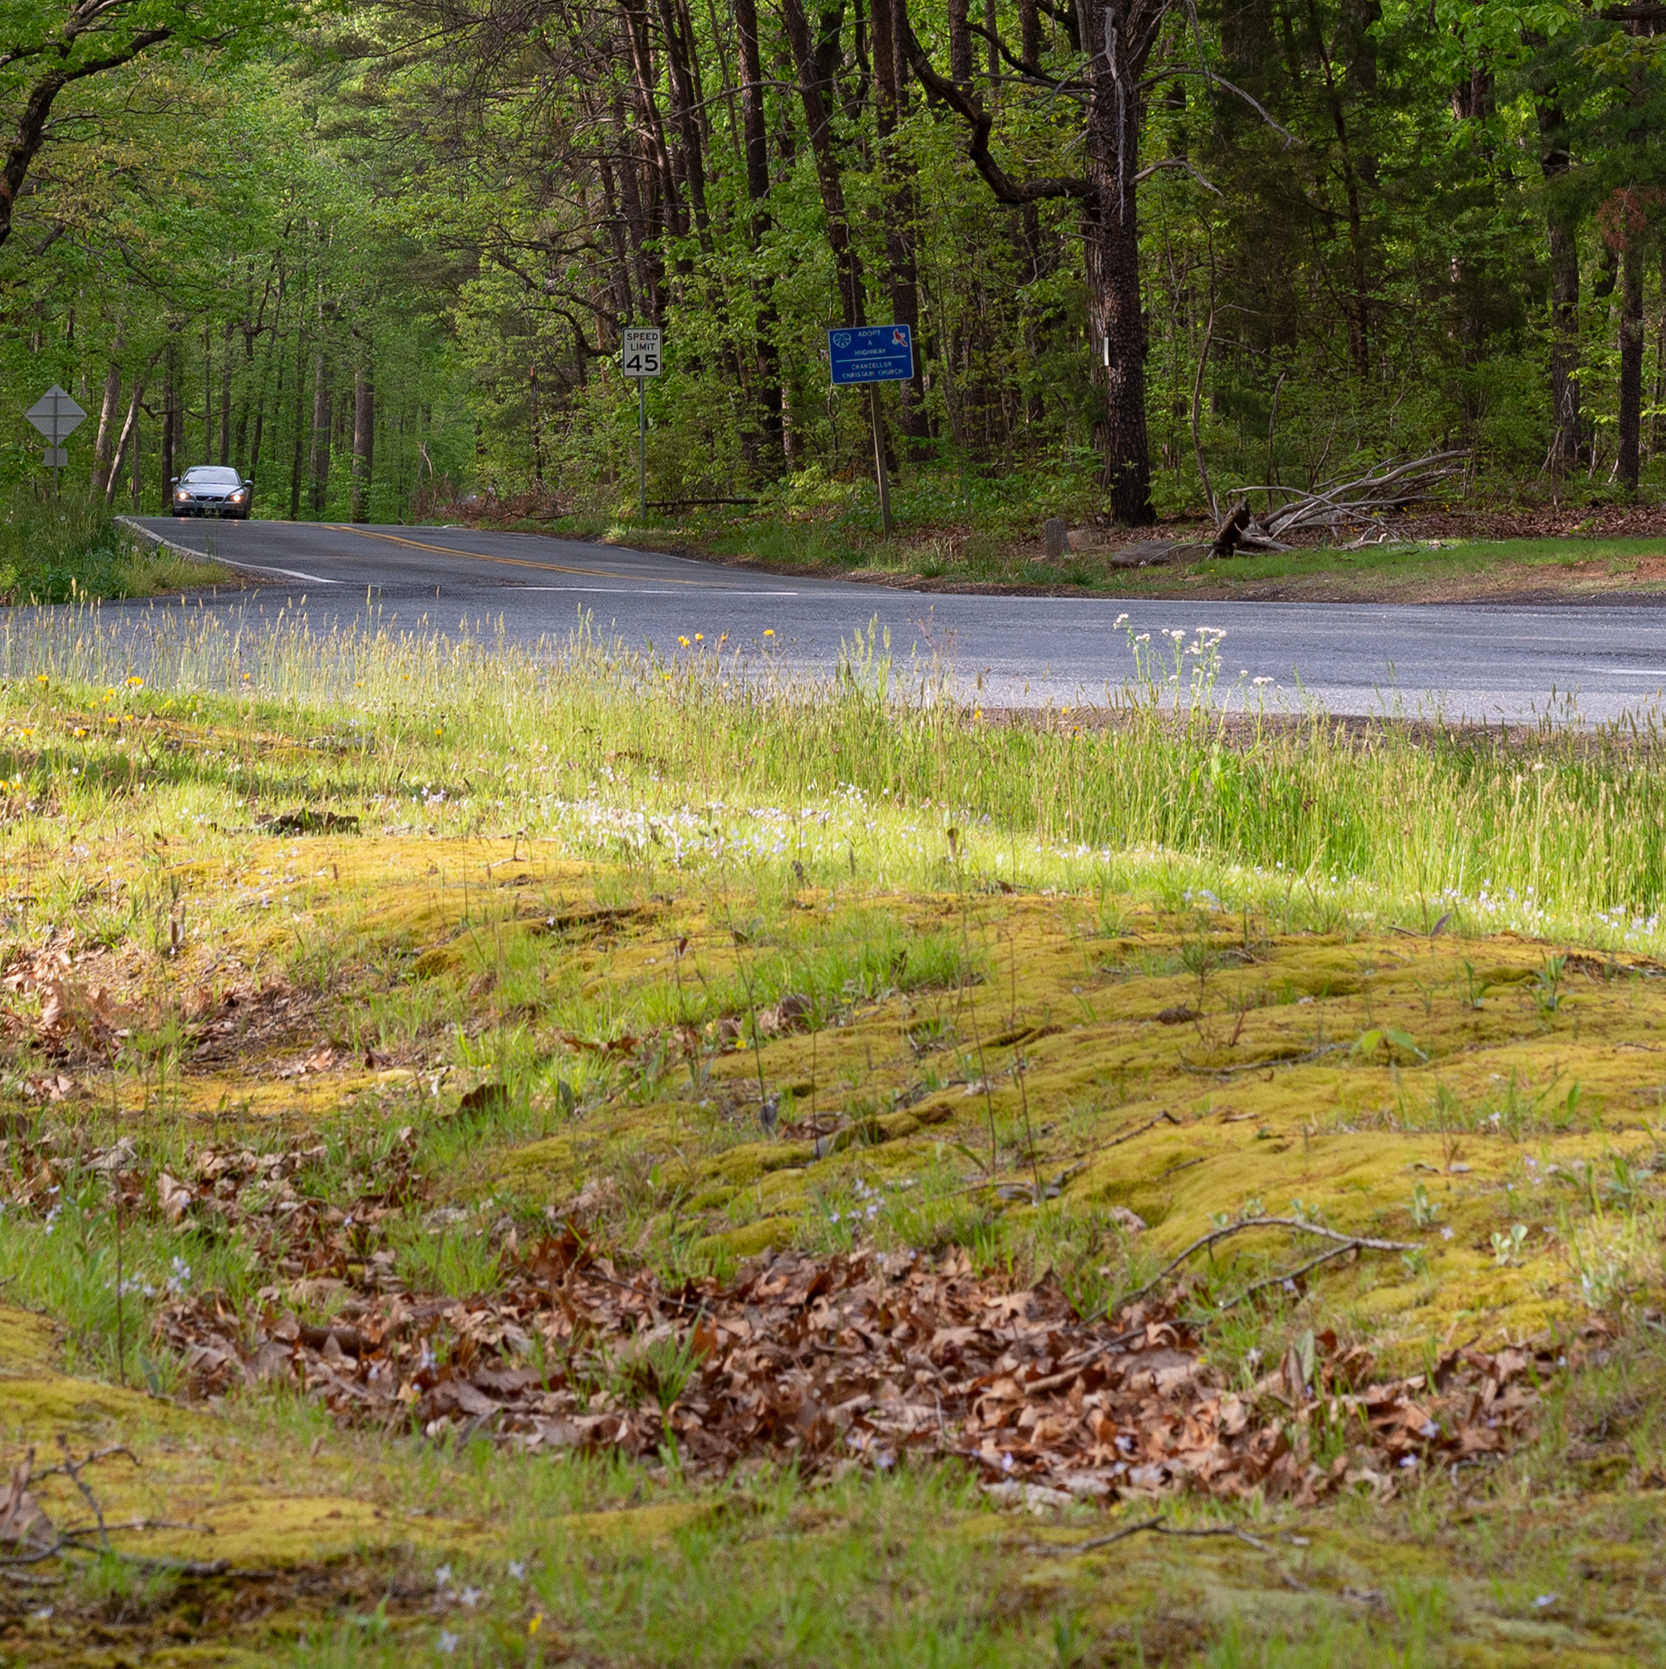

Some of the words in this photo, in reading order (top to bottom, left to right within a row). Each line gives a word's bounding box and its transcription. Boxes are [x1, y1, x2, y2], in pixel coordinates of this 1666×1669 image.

[627, 333, 658, 341] SPEED
[630, 343, 655, 351] LIMIT
[626, 354, 658, 372] 45
[852, 362, 892, 370] CHANCELLOR
